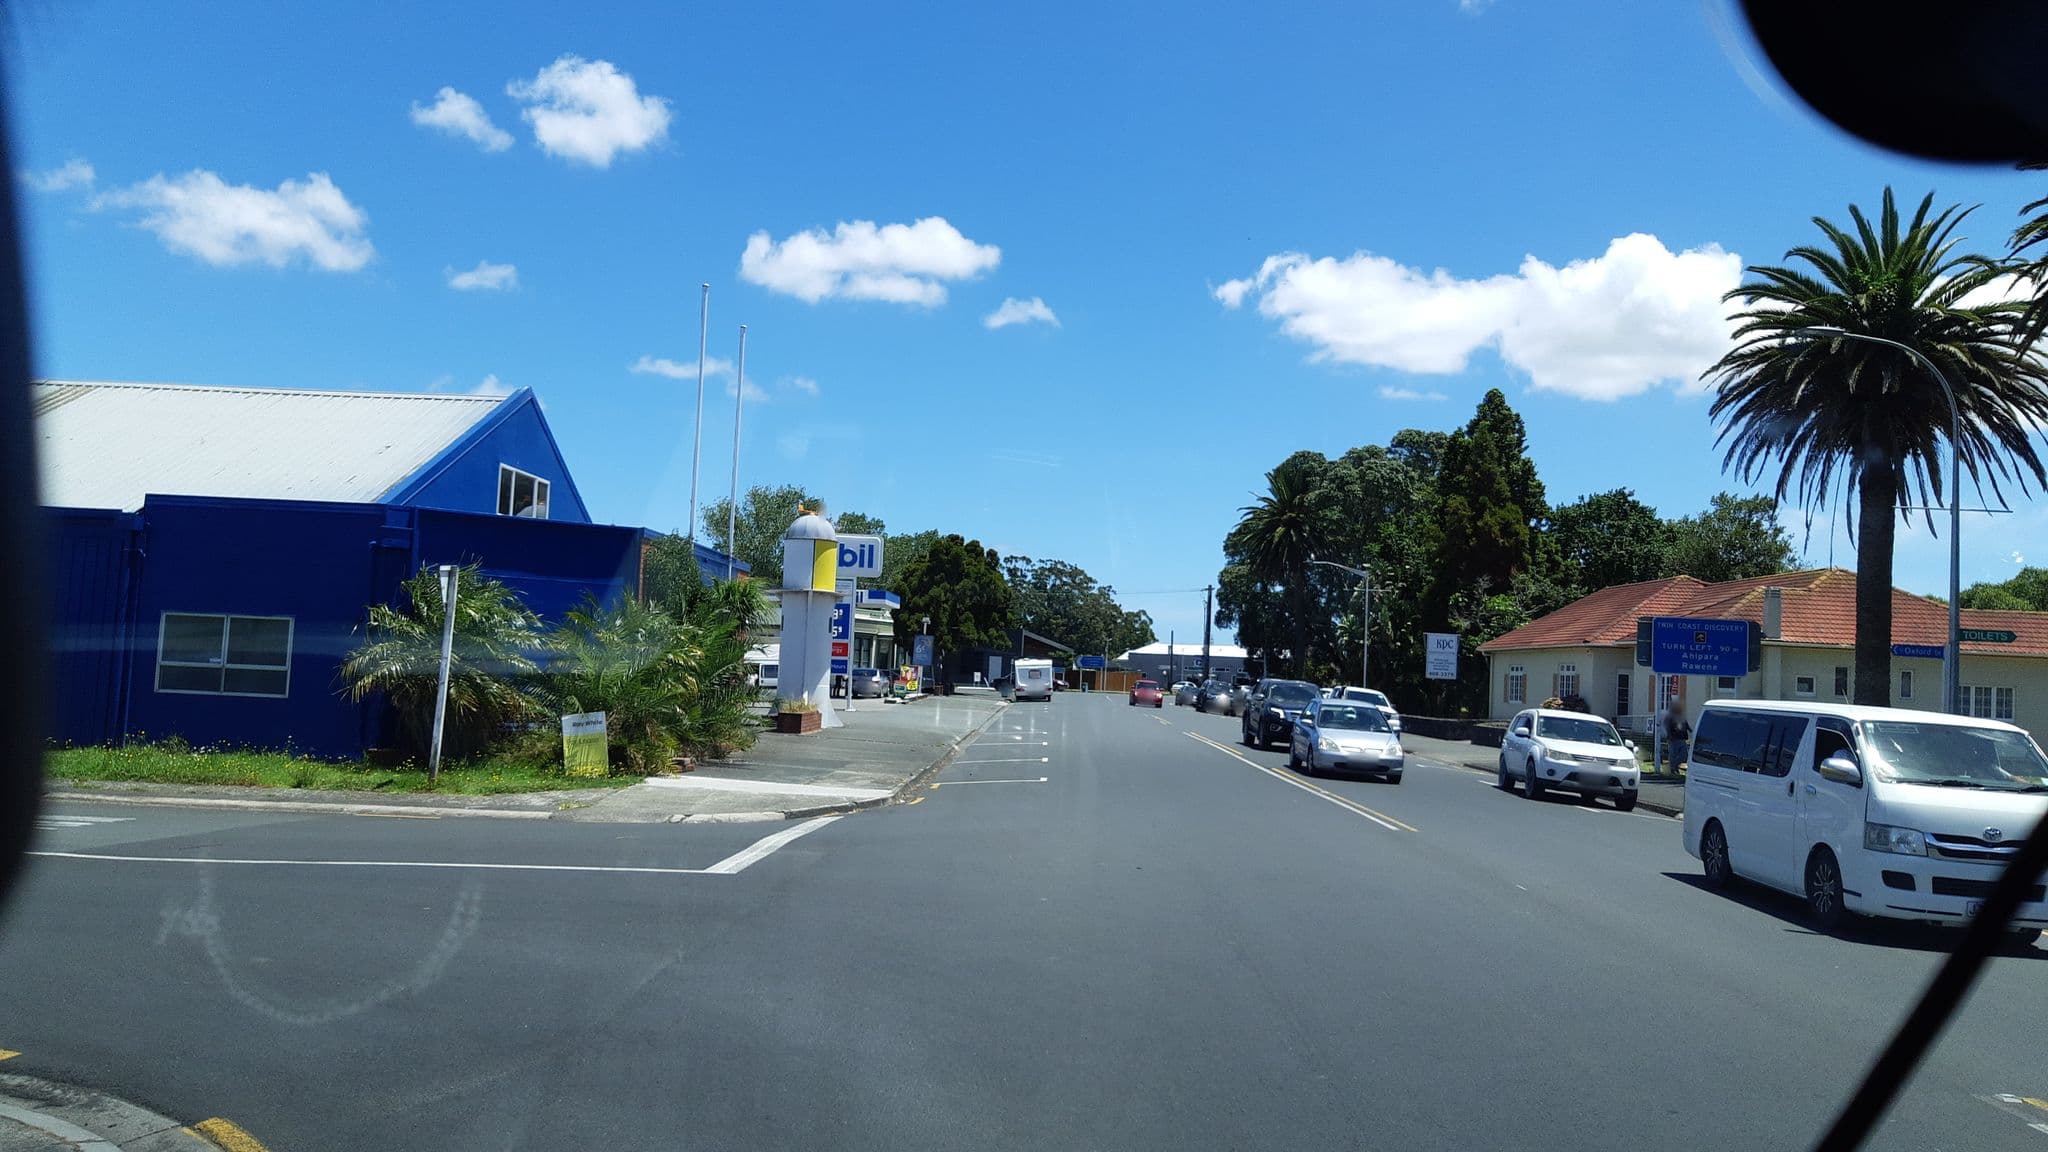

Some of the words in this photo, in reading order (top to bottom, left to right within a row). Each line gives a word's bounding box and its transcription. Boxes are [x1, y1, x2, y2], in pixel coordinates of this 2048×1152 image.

[838, 543, 874, 568] bil
[1657, 621, 1673, 629] TWIN
[1679, 622, 1700, 630] COAST
[1705, 623, 1744, 632] DISCOVERY
[1963, 630, 2008, 641] TOILETS
[1662, 642, 1685, 650] TURN
[1690, 643, 1712, 651] LEFT
[1904, 646, 1931, 656] Oxford
[1681, 652, 1719, 661] Ahipara
[1681, 661, 1718, 671] Rawene
